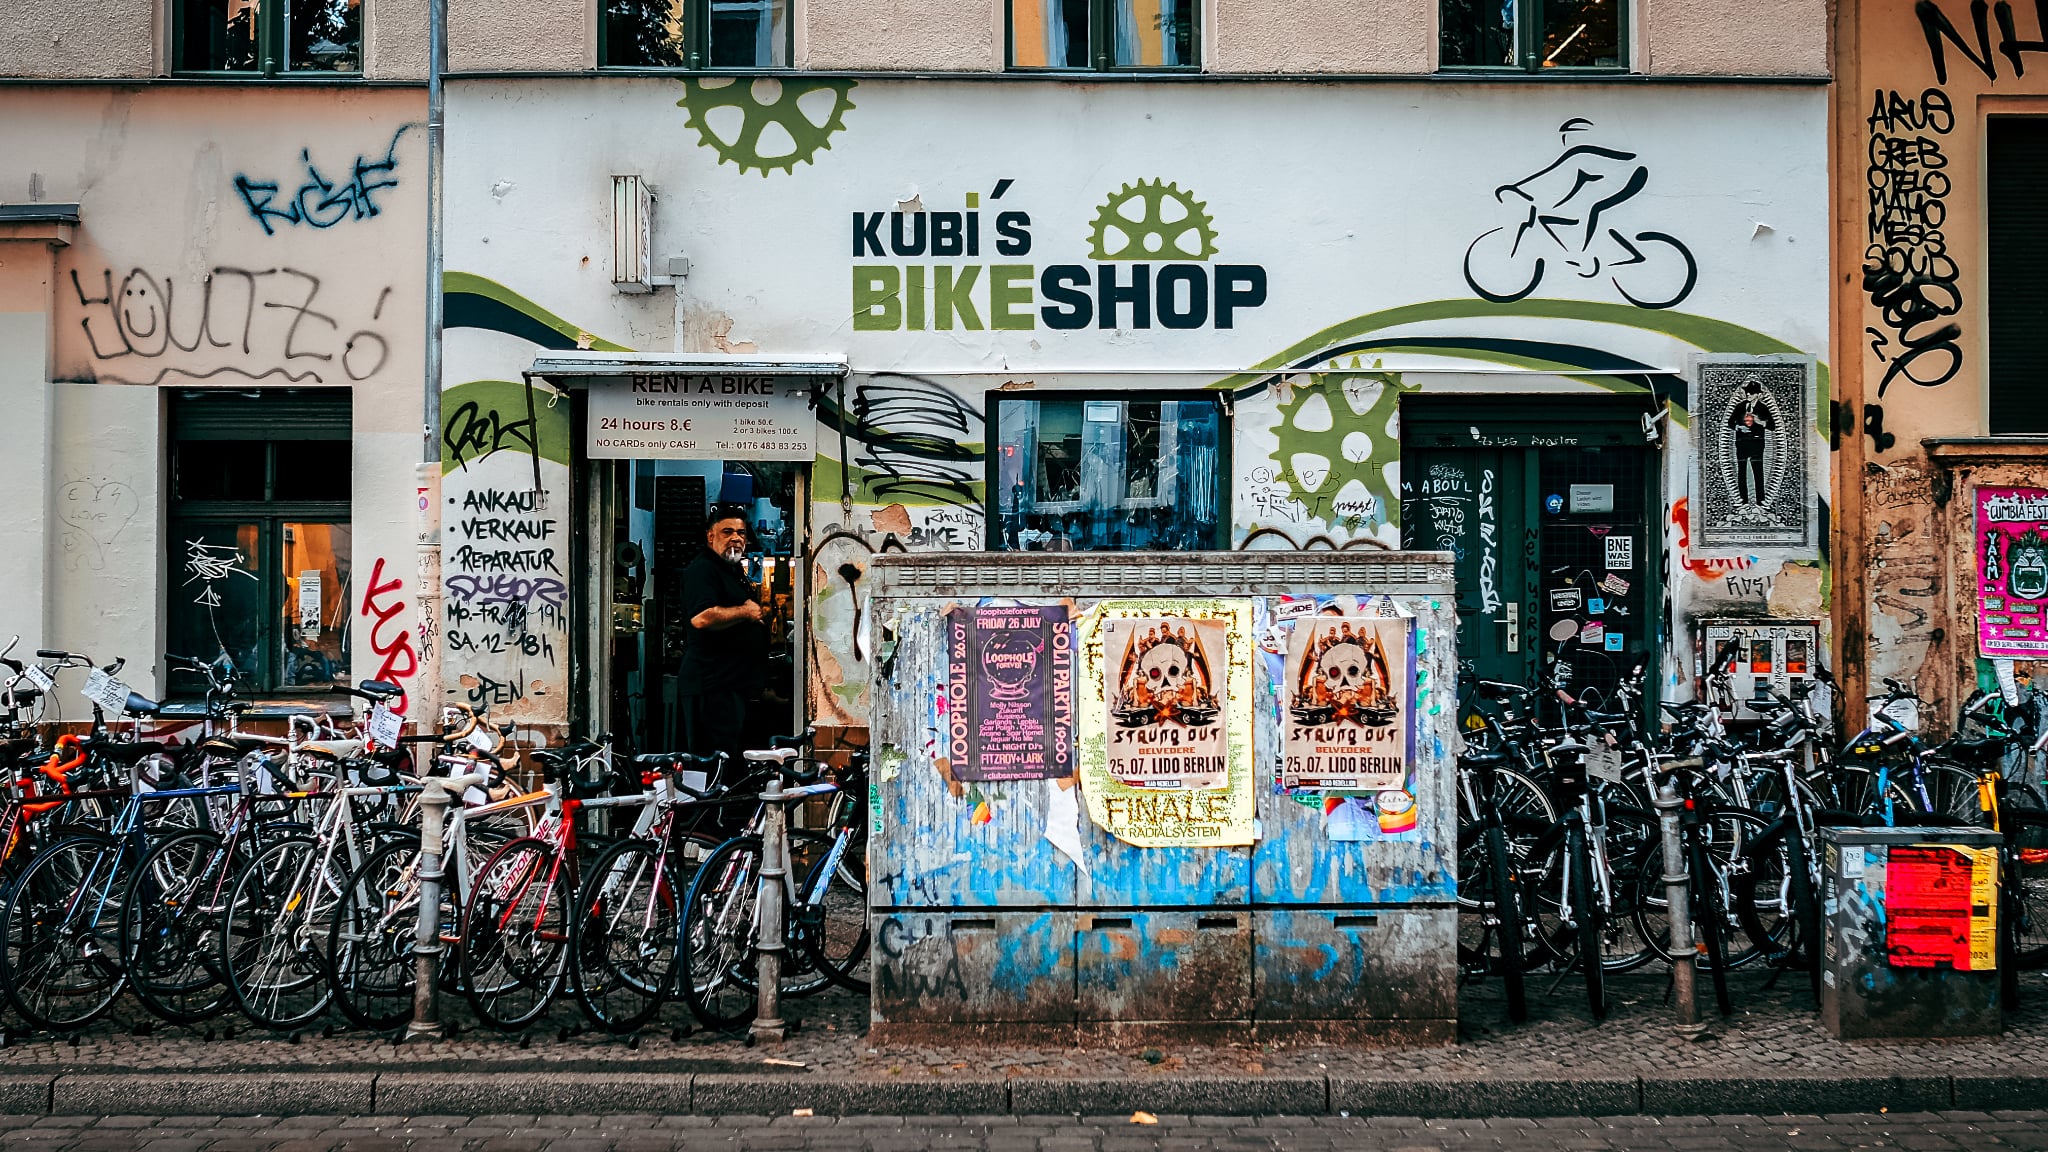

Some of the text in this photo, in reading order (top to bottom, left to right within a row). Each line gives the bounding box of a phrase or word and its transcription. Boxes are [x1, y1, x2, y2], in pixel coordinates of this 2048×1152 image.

[631, 375, 774, 395] RENT A BIKE
[636, 397, 769, 410] bike rentals only with deposit
[600, 417, 692, 432] 24 hours 8.€
[596, 439, 697, 450] NO CARDs only CASH
[716, 441, 735, 450] Tel.:
[736, 442, 758, 450] 0176
[760, 442, 776, 450] 483
[791, 442, 808, 451] 253
[463, 487, 550, 515] ANKAU
[1990, 505, 2025, 520] CUMBIA
[461, 516, 557, 543] VERKAUF
[1607, 538, 1630, 552] BNE
[456, 544, 563, 577] REPARATUR
[1987, 532, 1999, 580] YAAM
[1607, 560, 1630, 568] HERE
[976, 617, 1041, 629] FRIDAY 26 JULY
[954, 623, 966, 658] 26.07
[1052, 622, 1070, 665] SOLI
[985, 652, 1034, 664] LOOPHOLE
[1054, 667, 1071, 726] PARTY
[950, 663, 968, 765] LOOPHOLE
[1187, 727, 1221, 743] OUT
[1365, 728, 1397, 743] OUT
[1138, 747, 1195, 755] BELVEDERE
[1315, 746, 1373, 754] BELVEDERE
[1110, 756, 1225, 774] 25.07. LIDO BERLIN
[1286, 757, 1401, 774] 25.07. LIDO BERLIN
[1104, 794, 1229, 826] FINALE
[1113, 826, 1221, 838] AT RADIALSYSTEM
